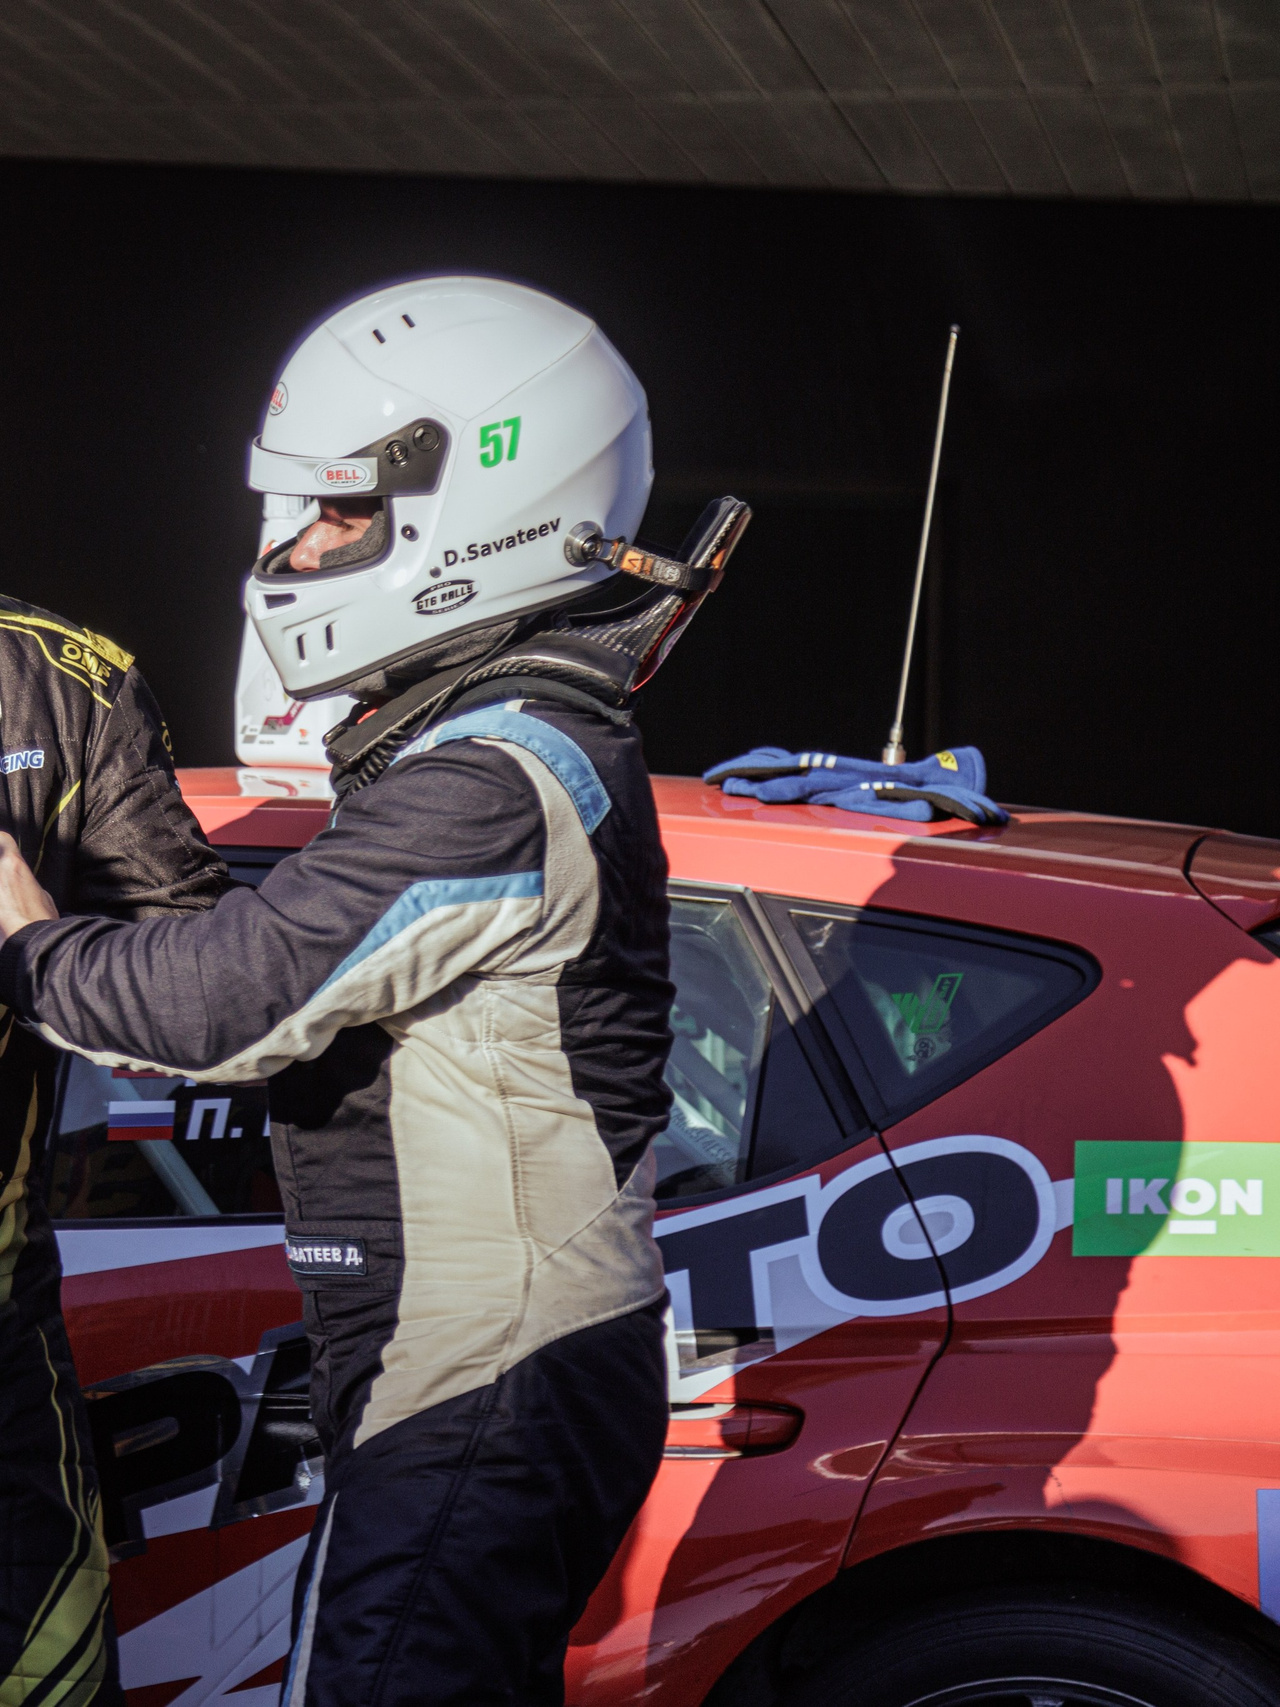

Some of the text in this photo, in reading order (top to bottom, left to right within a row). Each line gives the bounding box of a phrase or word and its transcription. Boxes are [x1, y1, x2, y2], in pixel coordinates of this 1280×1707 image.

[480, 415, 521, 468] 57
[326, 469, 360, 481] BELL
[443, 517, 561, 567] D.Savateev
[416, 583, 474, 611] GT6 RALLY
[61, 642, 111, 680] OMP
[1106, 1177, 1263, 1217] IKON
[345, 1247, 363, 1265] Д.
